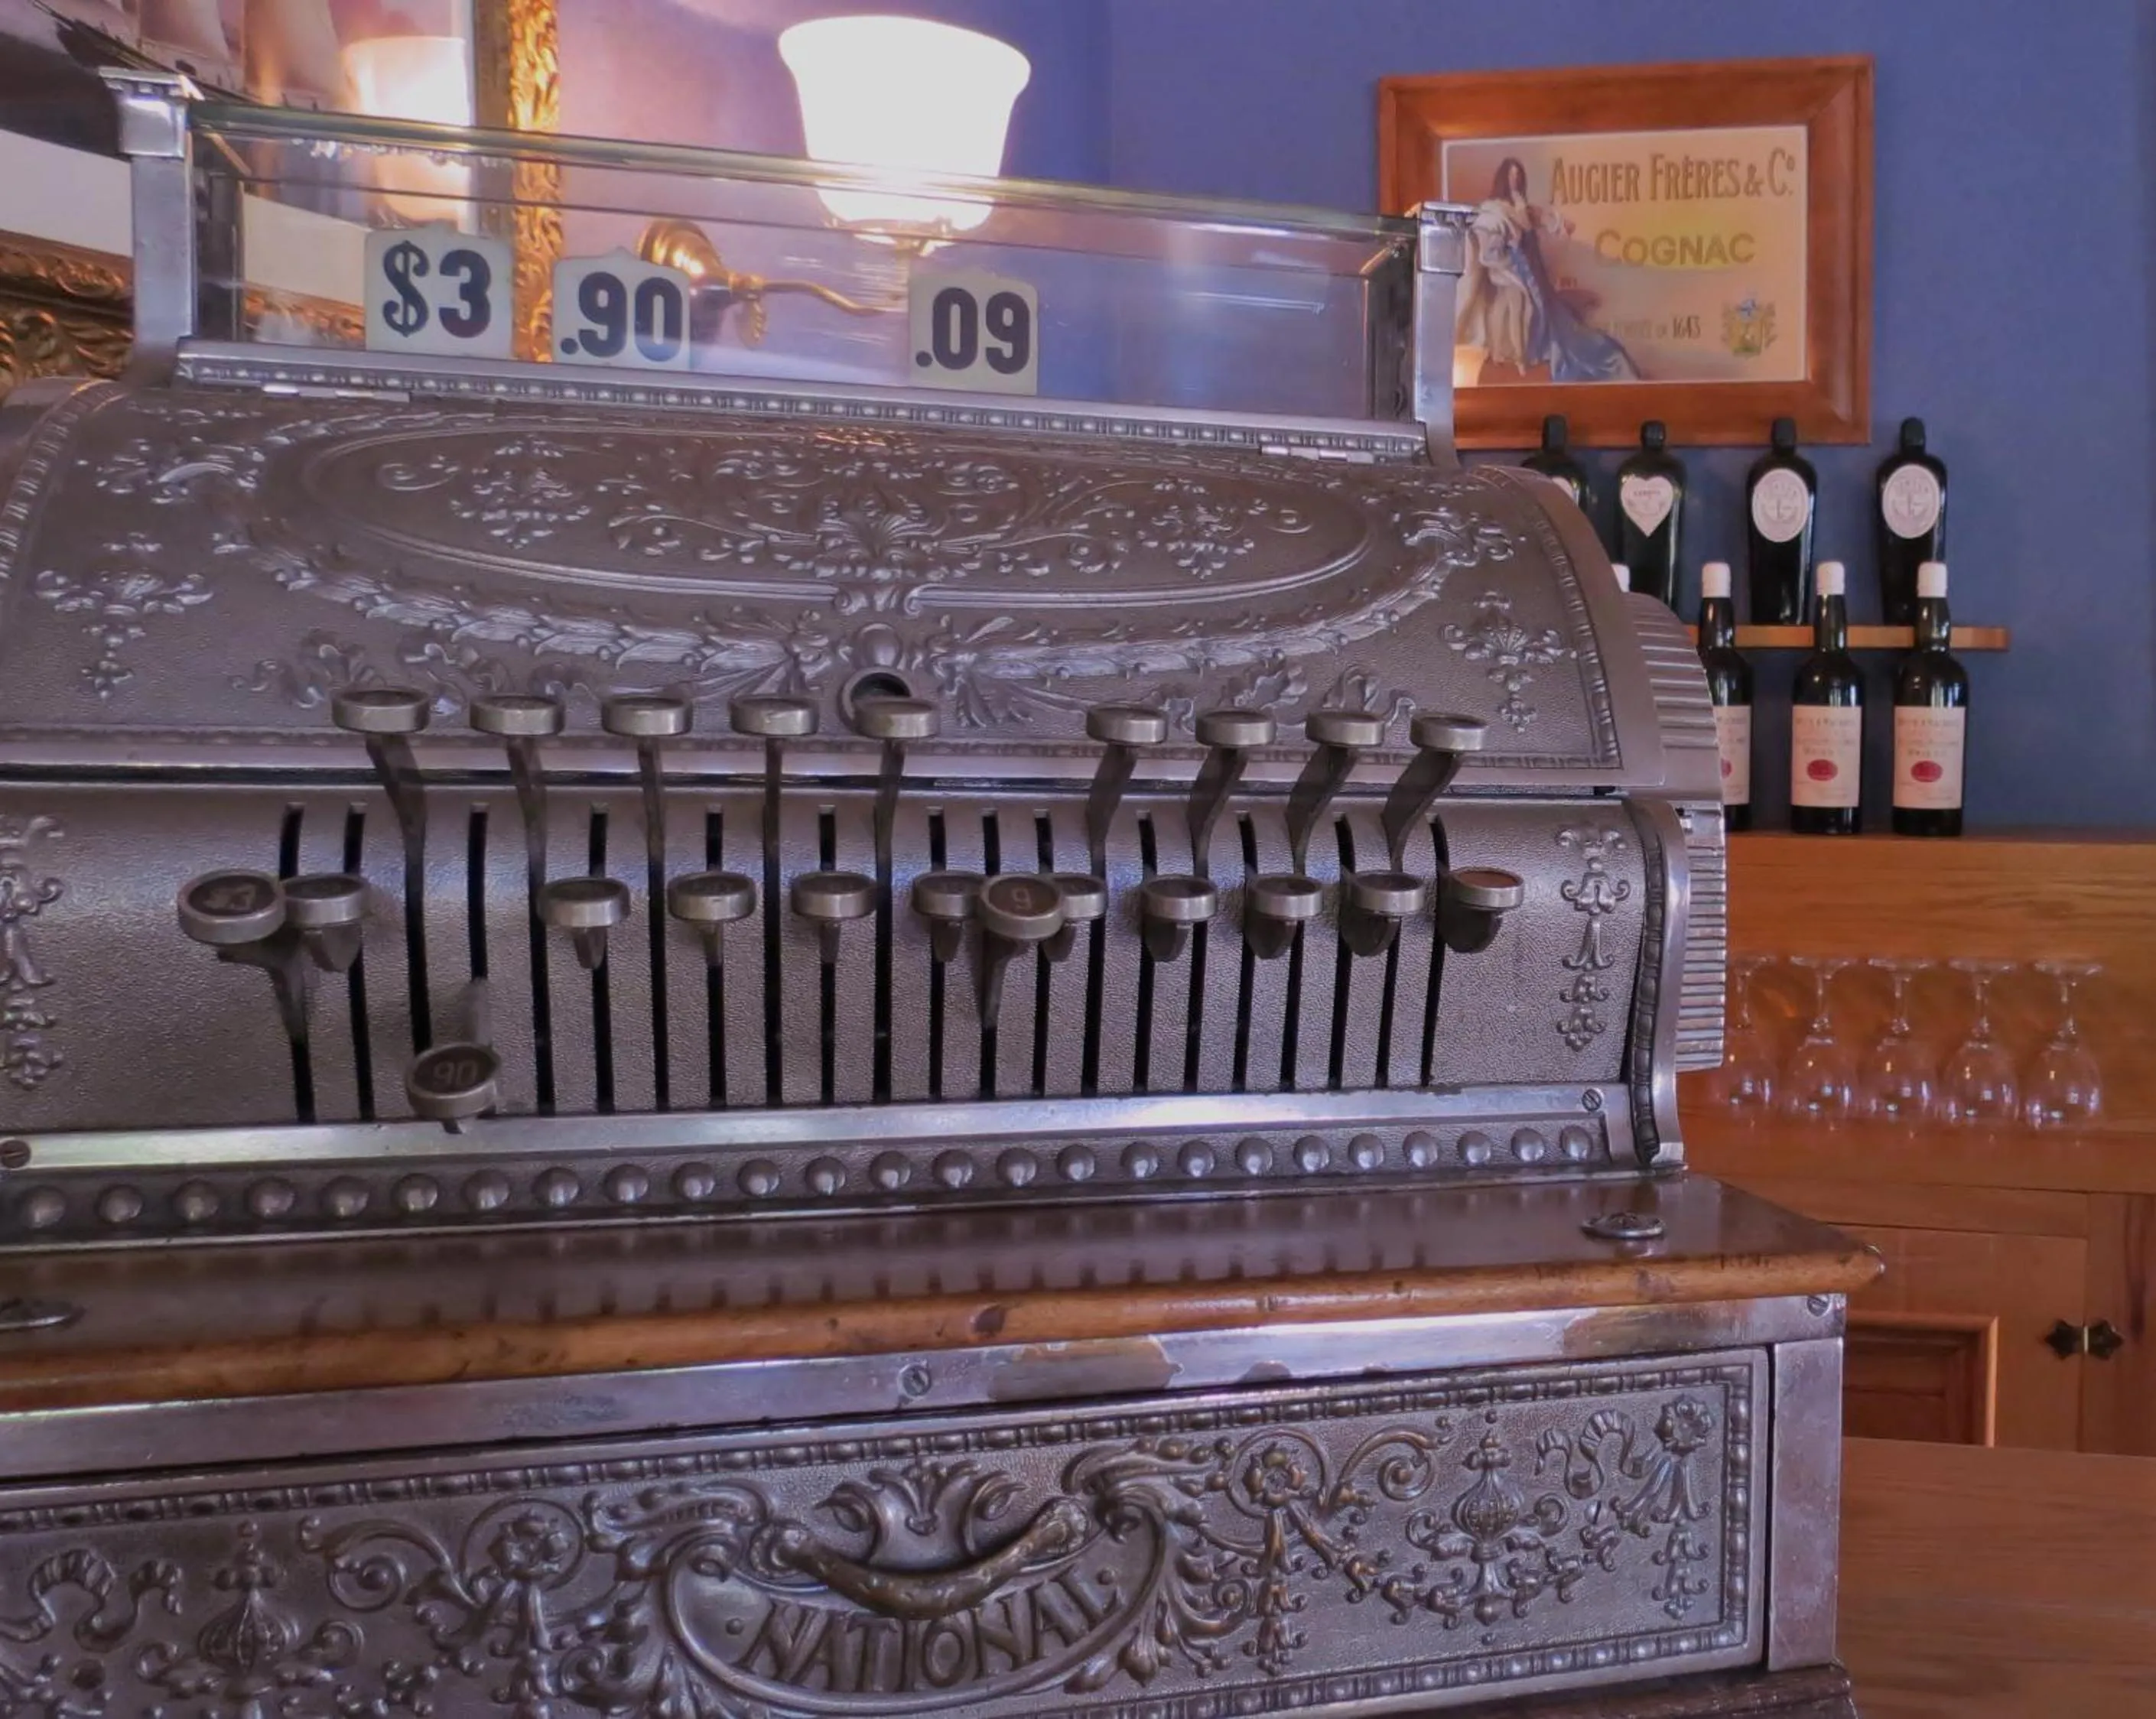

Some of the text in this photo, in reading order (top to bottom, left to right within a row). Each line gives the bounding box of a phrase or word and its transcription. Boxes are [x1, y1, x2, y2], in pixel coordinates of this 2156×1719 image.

[1550, 157, 1640, 205] AUGIER
[382, 239, 491, 338] $3
[1595, 229, 1756, 266] COGNAC
[559, 271, 683, 362] .90
[915, 286, 1030, 375] .09
[733, 1574, 1123, 1692] NATIONAL
